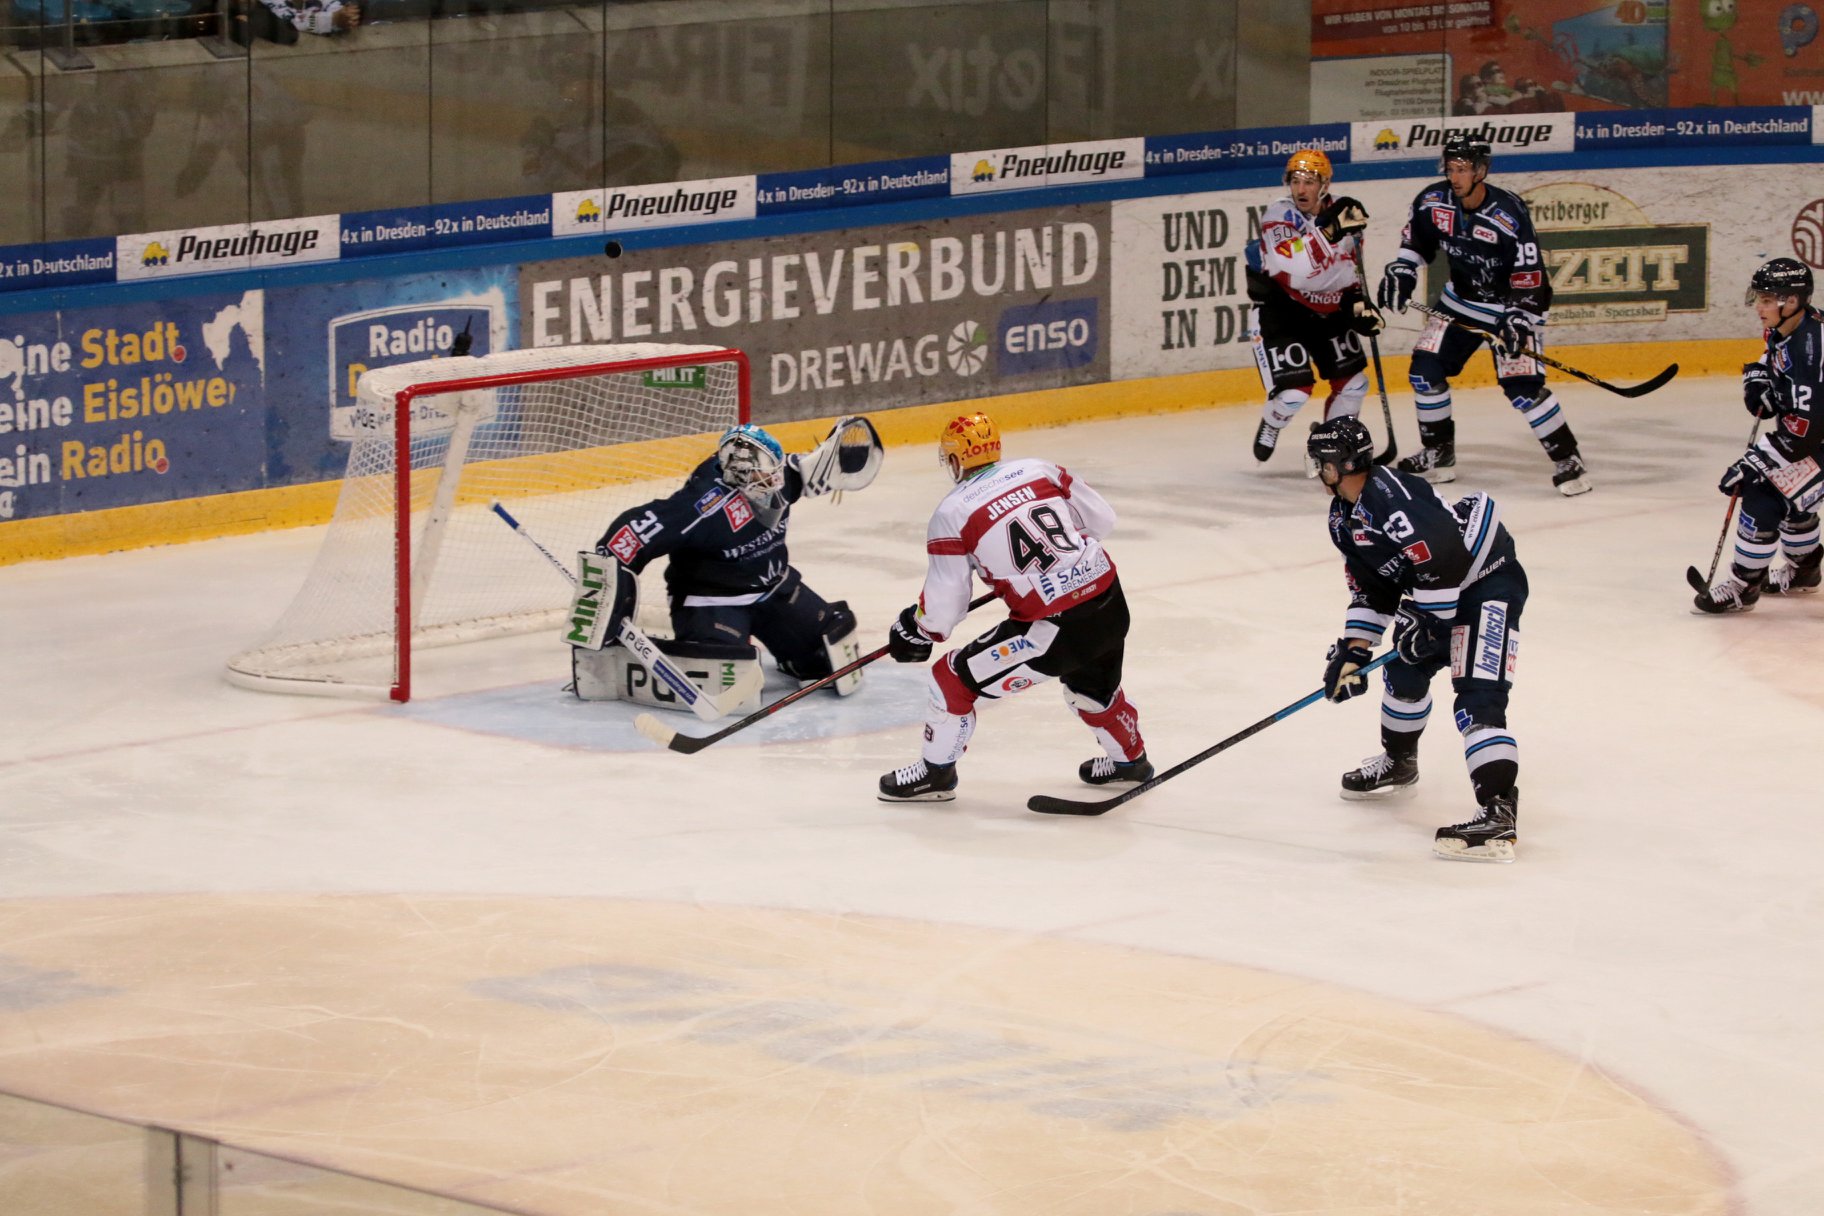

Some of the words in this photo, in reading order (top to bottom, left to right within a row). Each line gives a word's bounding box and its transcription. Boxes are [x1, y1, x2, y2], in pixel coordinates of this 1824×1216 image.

[1597, 124, 1609, 138] in
[1708, 120, 1720, 134] in
[1724, 117, 1808, 133] Deutschland
[1000, 149, 1126, 178] Pneuhage
[1163, 149, 1175, 163] in
[1257, 141, 1269, 156] in
[1272, 136, 1347, 154] Deutschland
[775, 187, 787, 202] in
[868, 177, 879, 191] in
[881, 168, 948, 189] Deutschland
[607, 189, 738, 219] Pneuhage
[361, 227, 373, 242] in
[462, 216, 474, 232] in
[477, 208, 550, 230] Deutschland
[1162, 208, 1229, 252] UND
[176, 229, 319, 262] Pneuhage
[17, 260, 30, 276] in
[33, 252, 113, 275] Deutschland
[1162, 256, 1237, 302] DEM
[1543, 244, 1689, 293] ZEIT
[533, 222, 1098, 348] ENERGIEVERBUND
[369, 317, 453, 358] Radio
[1161, 308, 1198, 350] IN
[0, 335, 72, 378] ine
[771, 334, 940, 395] DREWAG
[1744, 370, 1768, 380] UER
[83, 372, 236, 423] Eislöwe
[61, 430, 166, 480] Radio
[986, 486, 1037, 521] JENSEN
[630, 511, 665, 544] 31
[1006, 503, 1080, 574] 48
[613, 538, 634, 559] 24
